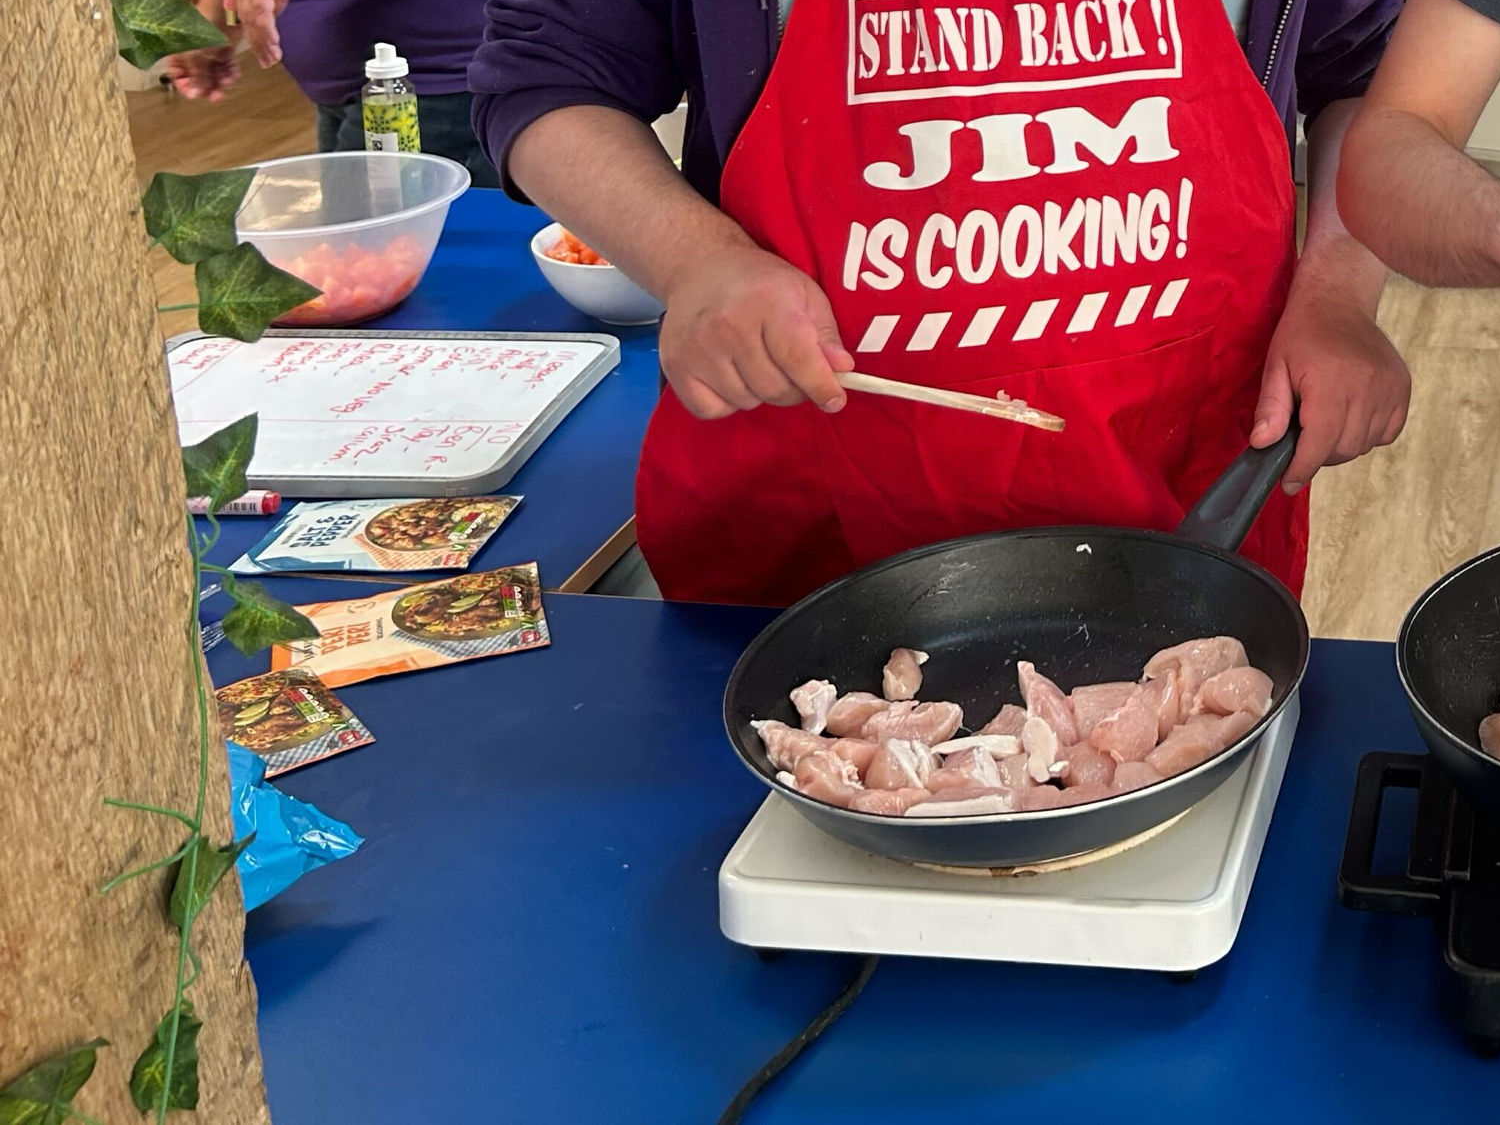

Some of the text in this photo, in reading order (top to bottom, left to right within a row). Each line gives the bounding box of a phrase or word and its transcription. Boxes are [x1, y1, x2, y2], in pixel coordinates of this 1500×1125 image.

[858, 7, 1004, 79] STAND
[862, 96, 1181, 191] JIM
[843, 177, 1194, 292] IS COOKING!
[400, 425, 450, 443] Jay
[424, 425, 484, 463] Ben R
[289, 526, 328, 548] SALT
[316, 516, 336, 525] &
[308, 513, 361, 548] PEPPER
[320, 625, 346, 655] PERI
[346, 620, 371, 647] PERI
